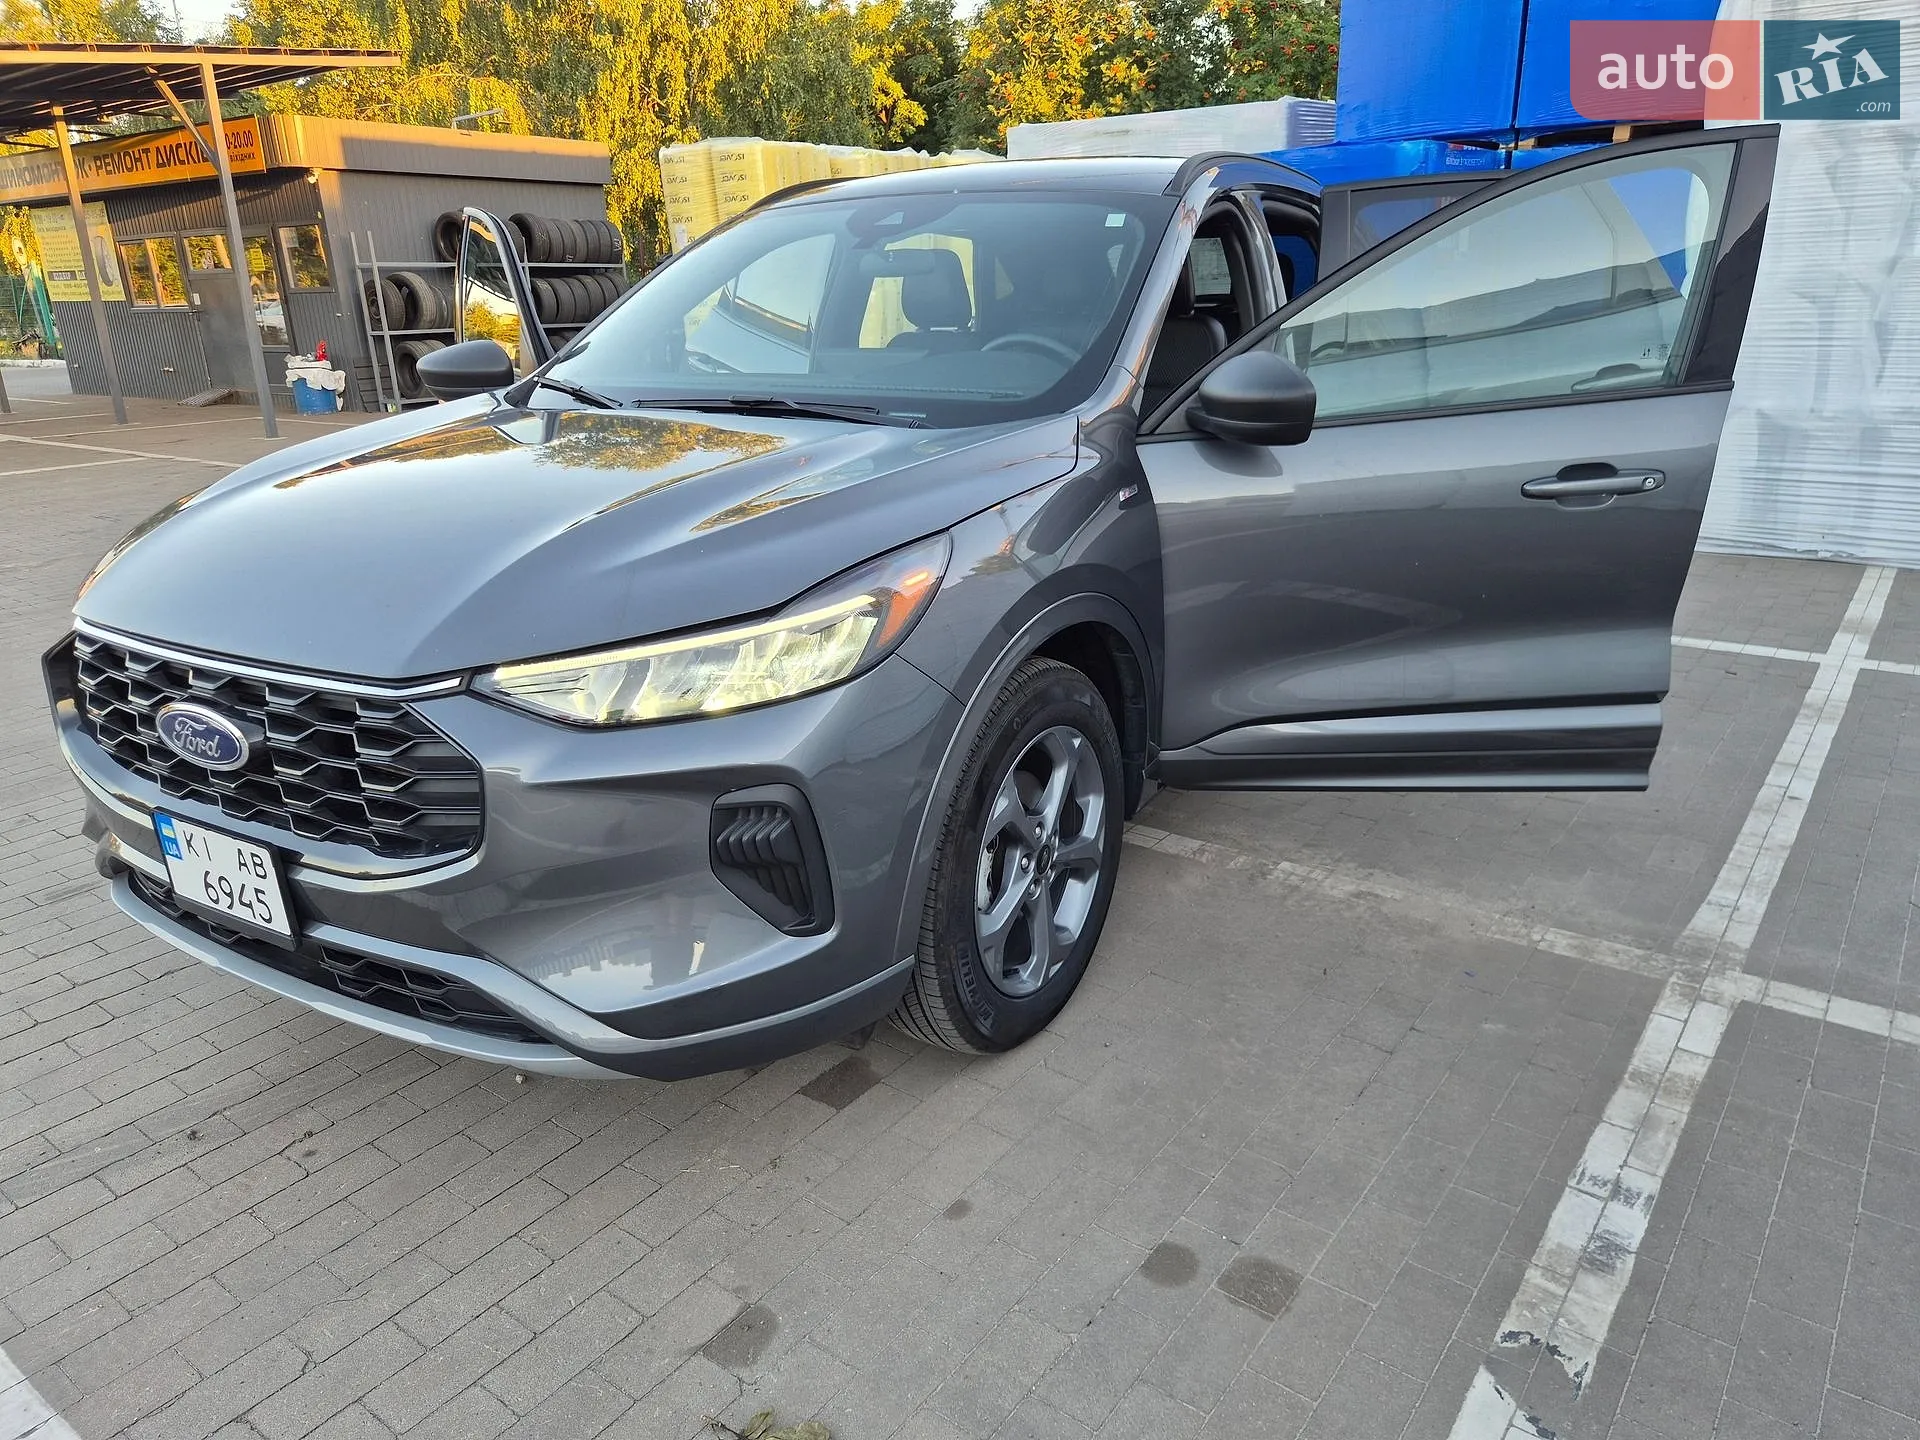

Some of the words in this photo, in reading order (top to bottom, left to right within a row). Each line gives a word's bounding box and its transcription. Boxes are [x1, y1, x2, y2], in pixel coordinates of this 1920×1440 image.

[94, 147, 151, 177] РЕМОНТ
[173, 717, 221, 758] Ford
[165, 841, 180, 857] UA
[237, 848, 268, 880] AB
[203, 870, 273, 924] 6945
